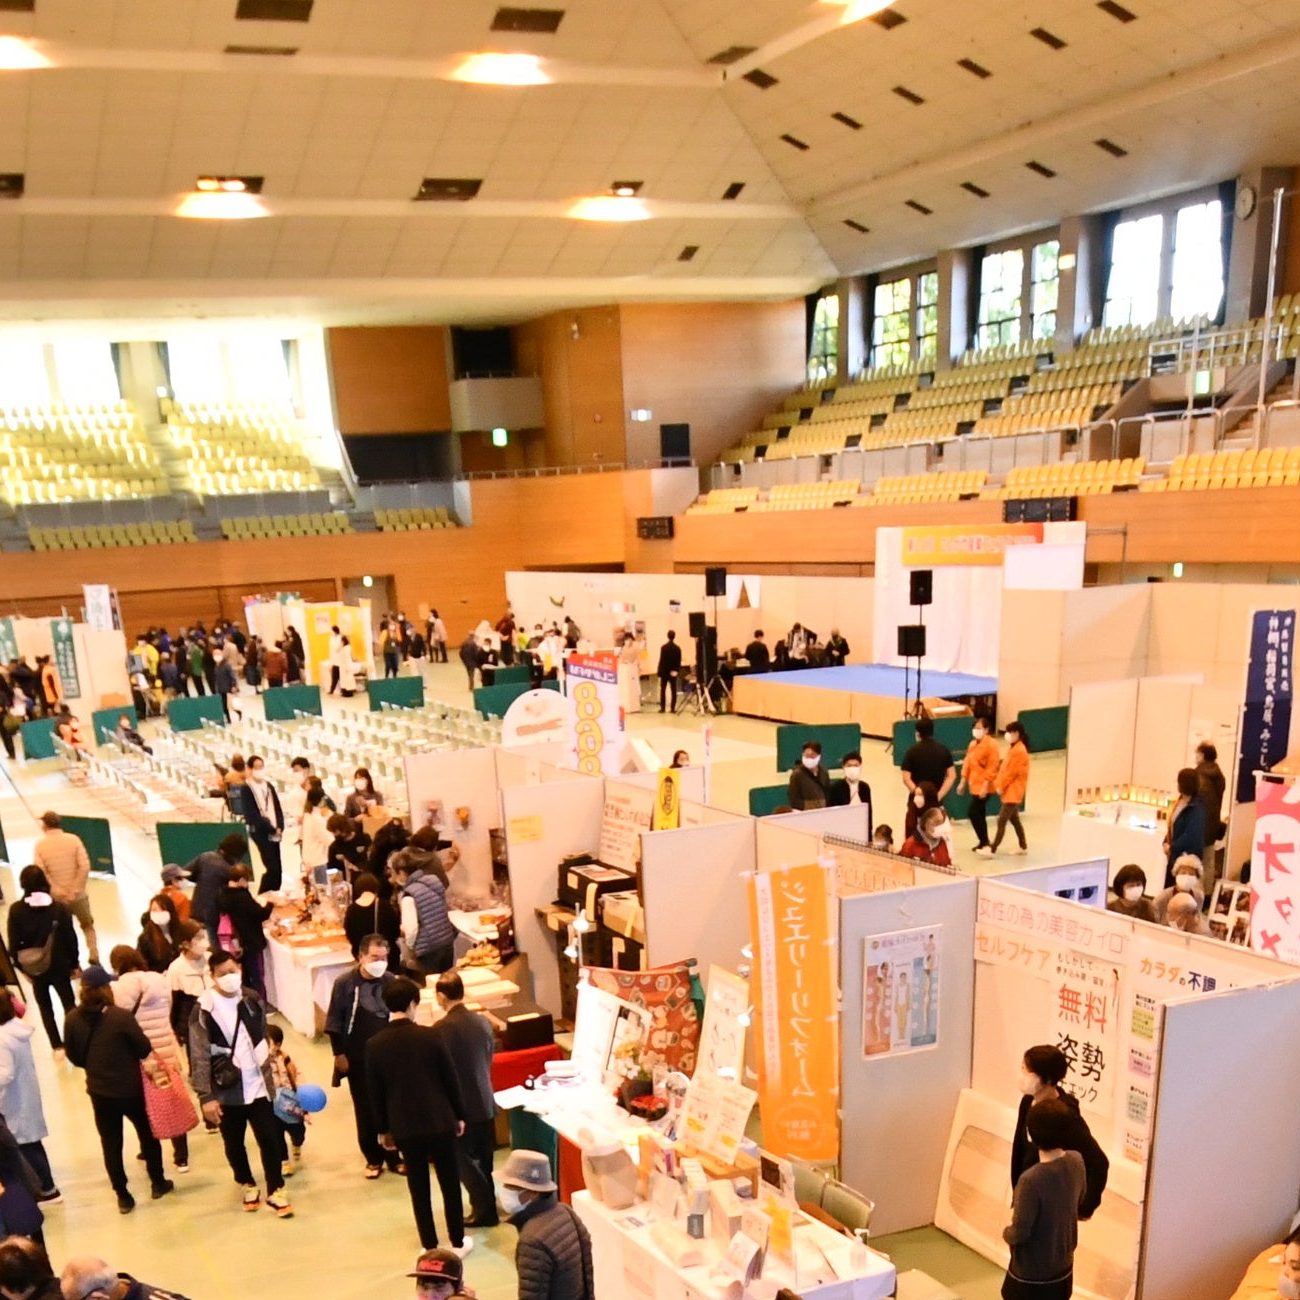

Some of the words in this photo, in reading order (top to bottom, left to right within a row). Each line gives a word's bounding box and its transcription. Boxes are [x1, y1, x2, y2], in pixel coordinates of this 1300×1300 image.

[975, 931, 1051, 971] セルフケア
[1058, 982, 1108, 1035] 無料
[1055, 1031, 1106, 1083] 姿勢
